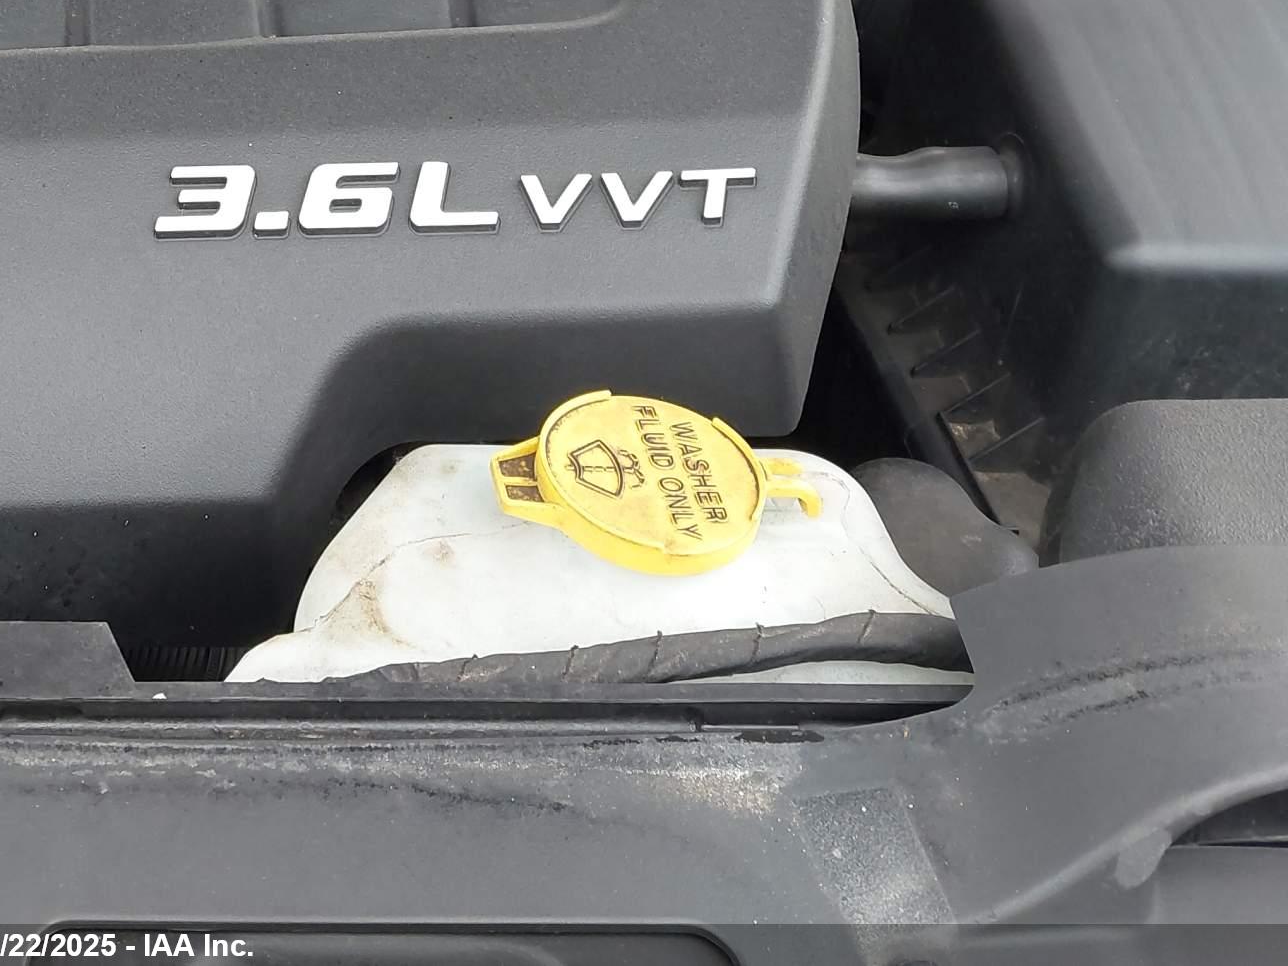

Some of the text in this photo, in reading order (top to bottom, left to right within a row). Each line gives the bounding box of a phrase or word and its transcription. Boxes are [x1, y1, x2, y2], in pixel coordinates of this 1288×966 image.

[153, 161, 757, 240] 3.6L VVT
[631, 405, 704, 541] FLUID ONLY
[669, 421, 728, 524] WASHER
